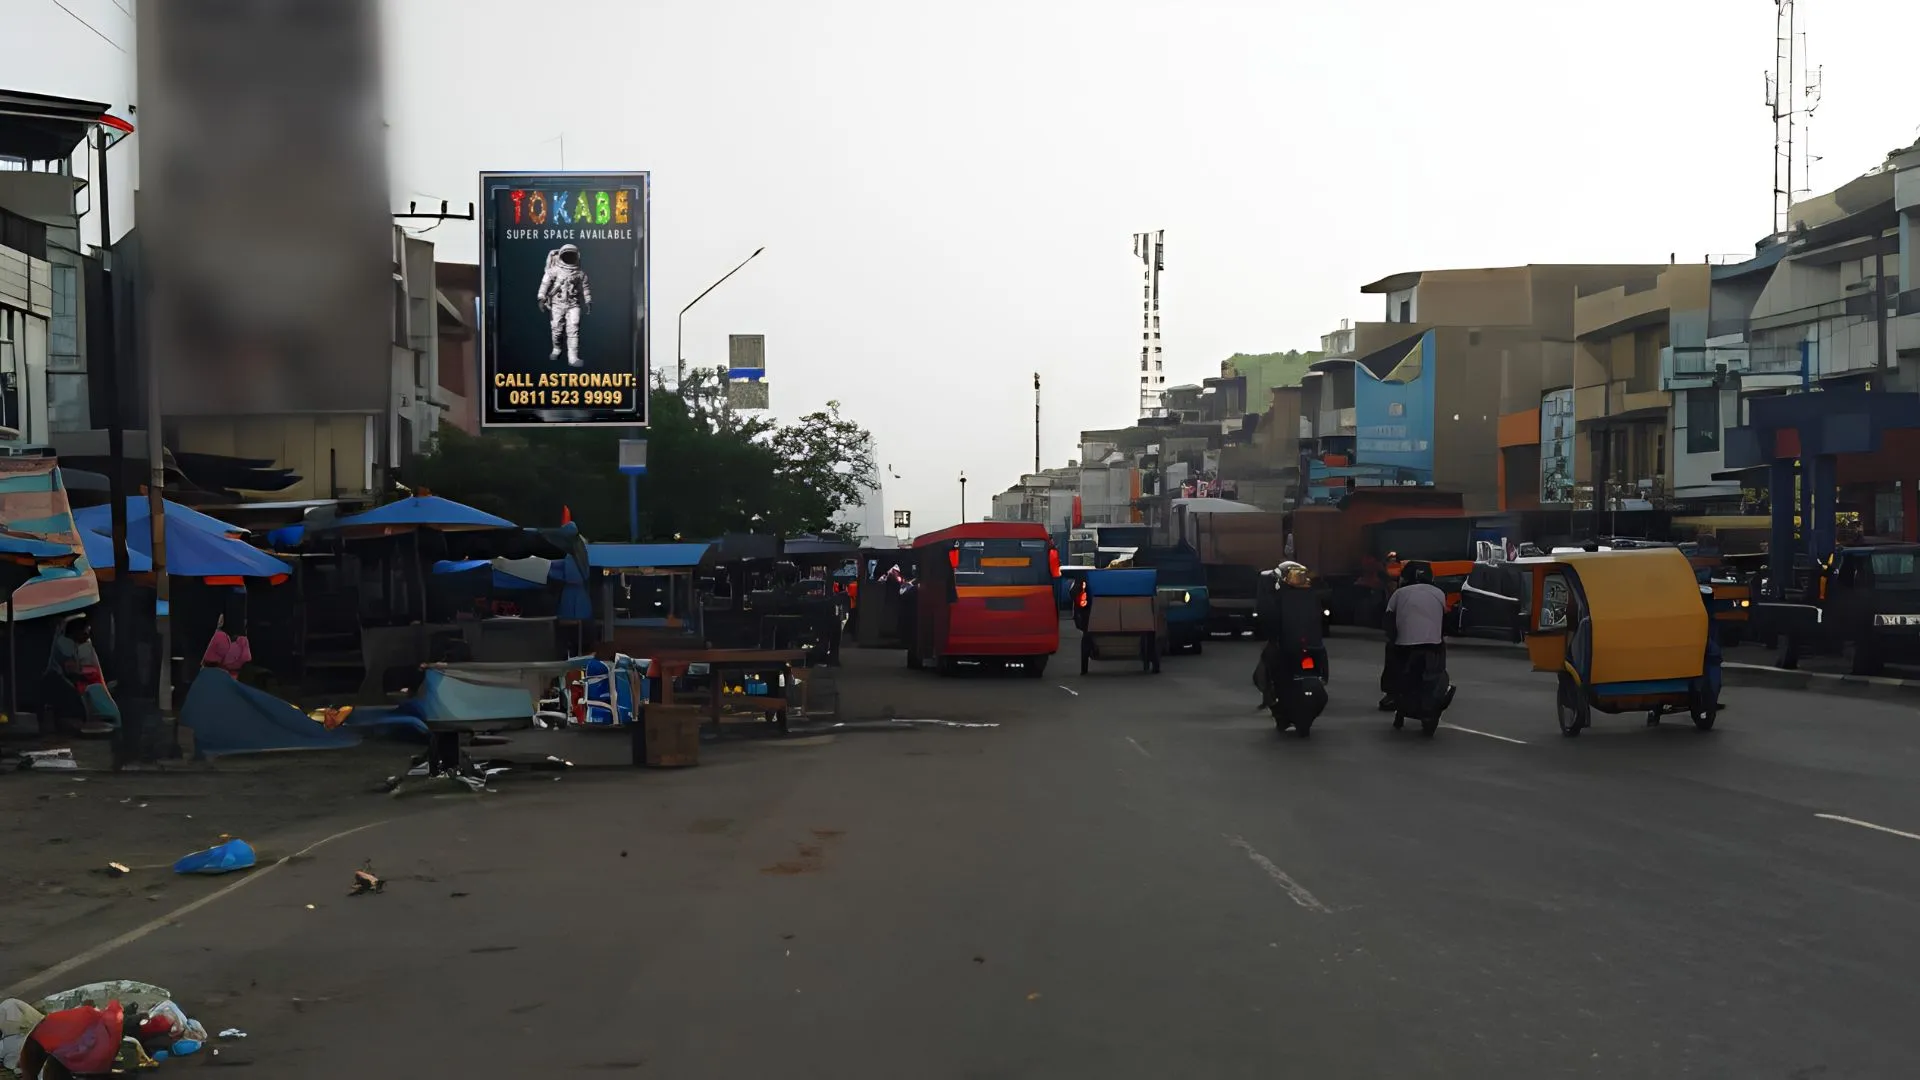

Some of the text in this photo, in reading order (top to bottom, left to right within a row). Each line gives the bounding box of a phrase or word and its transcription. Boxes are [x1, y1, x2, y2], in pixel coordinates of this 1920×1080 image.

[510, 189, 629, 224] TOKABE
[506, 229, 632, 240] SUPER SPACE AVAILABLE
[495, 373, 636, 387] CALL ASTRONAUT:
[509, 391, 622, 404] 0811 523 9999
